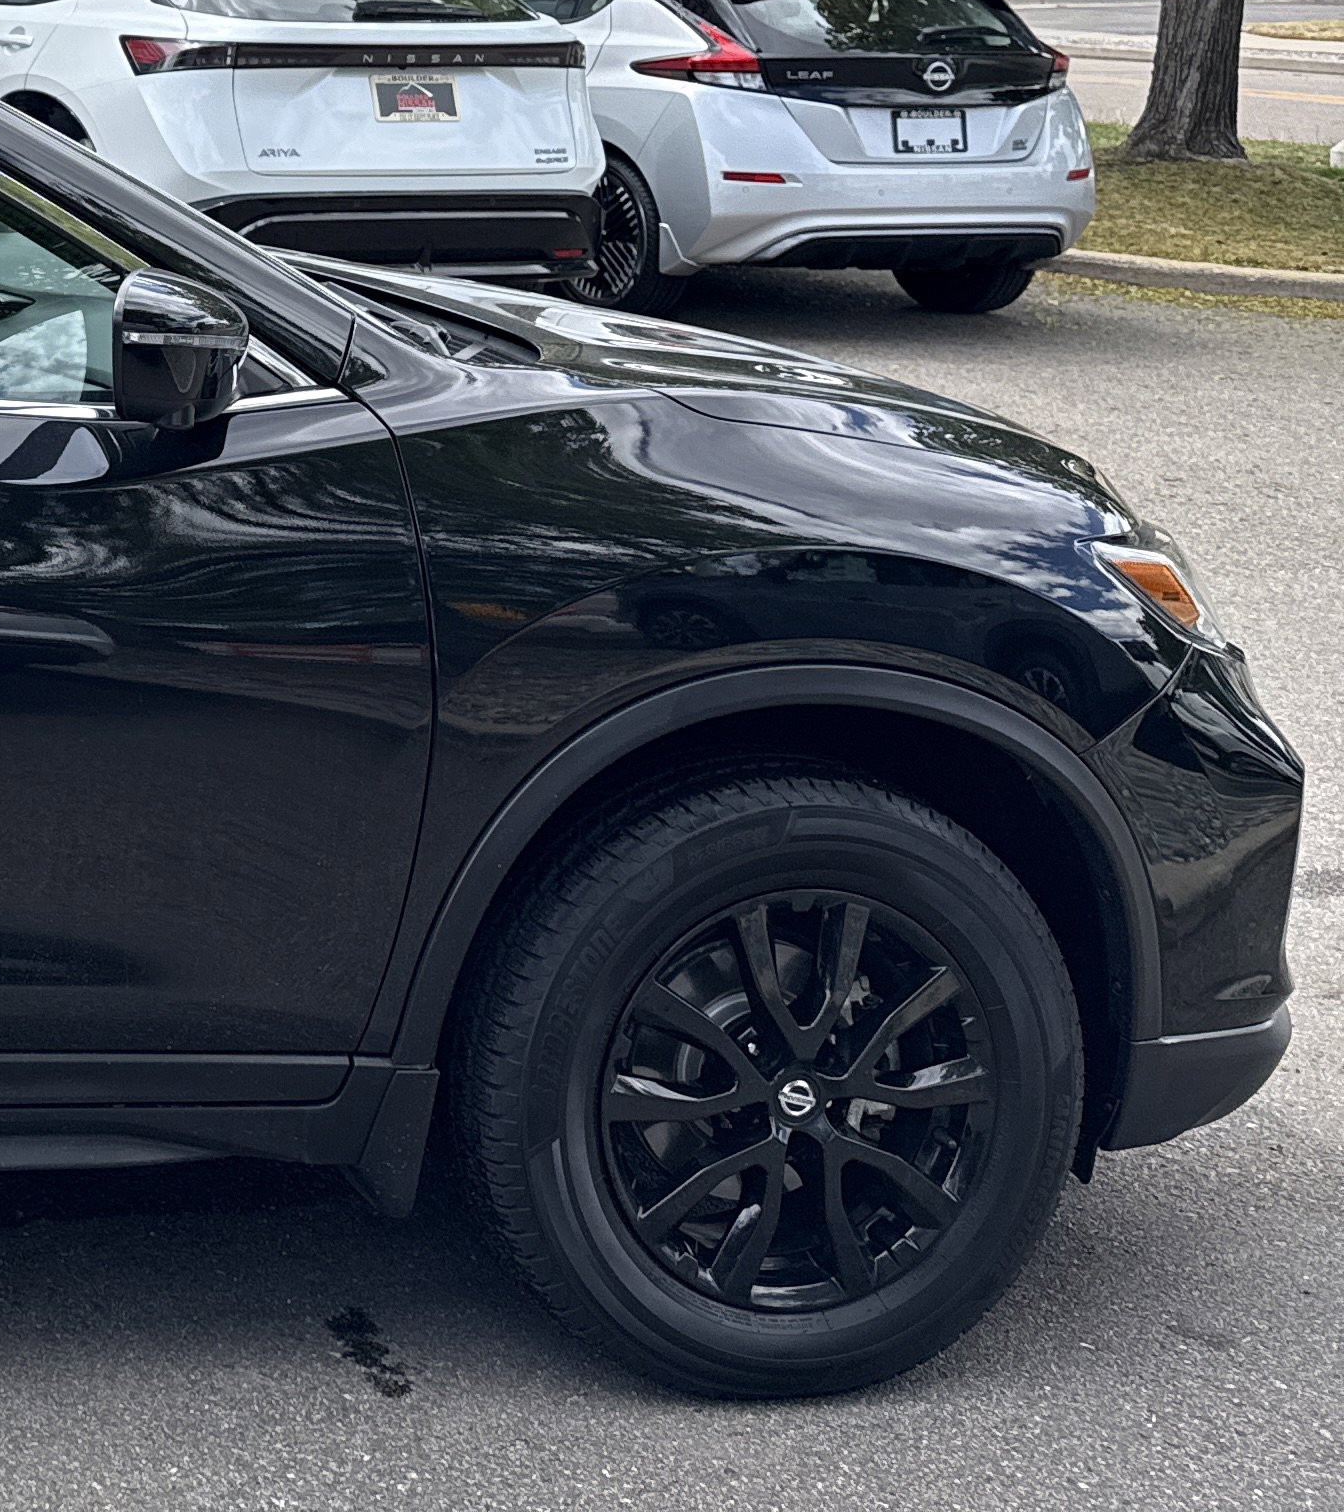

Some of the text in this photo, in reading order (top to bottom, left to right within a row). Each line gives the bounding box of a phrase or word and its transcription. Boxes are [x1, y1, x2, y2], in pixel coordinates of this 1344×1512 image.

[362, 53, 485, 63] NISSAN
[786, 71, 833, 80] LEAF
[258, 148, 301, 157] ARIYA
